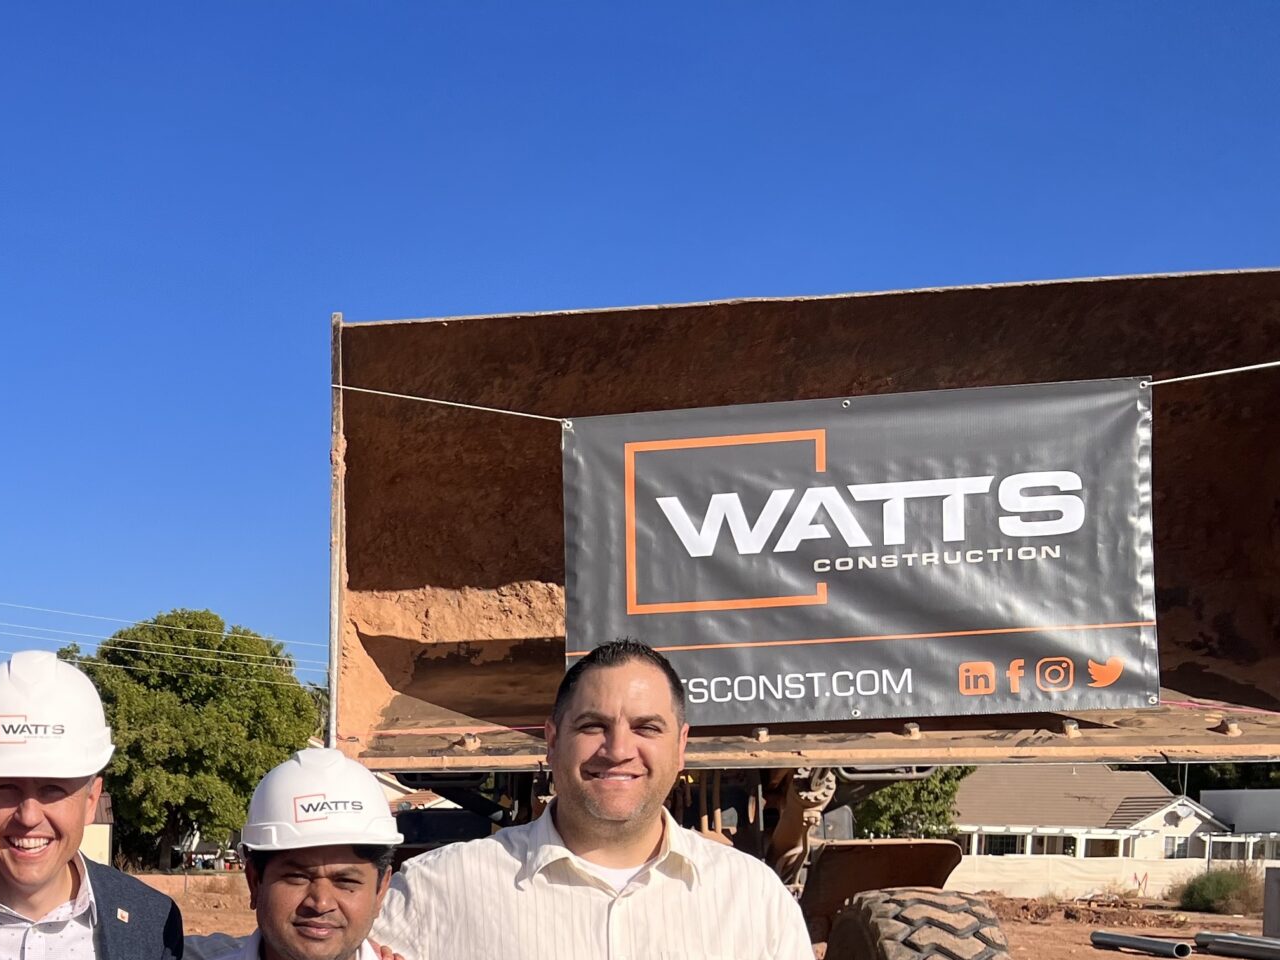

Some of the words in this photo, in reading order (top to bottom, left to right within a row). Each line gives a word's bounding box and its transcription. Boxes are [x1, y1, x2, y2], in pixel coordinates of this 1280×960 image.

[656, 471, 1085, 558] WATTS
[813, 545, 1061, 572] CONSTRUCTION
[1, 723, 65, 735] WATTS
[300, 800, 363, 813] WATTS
